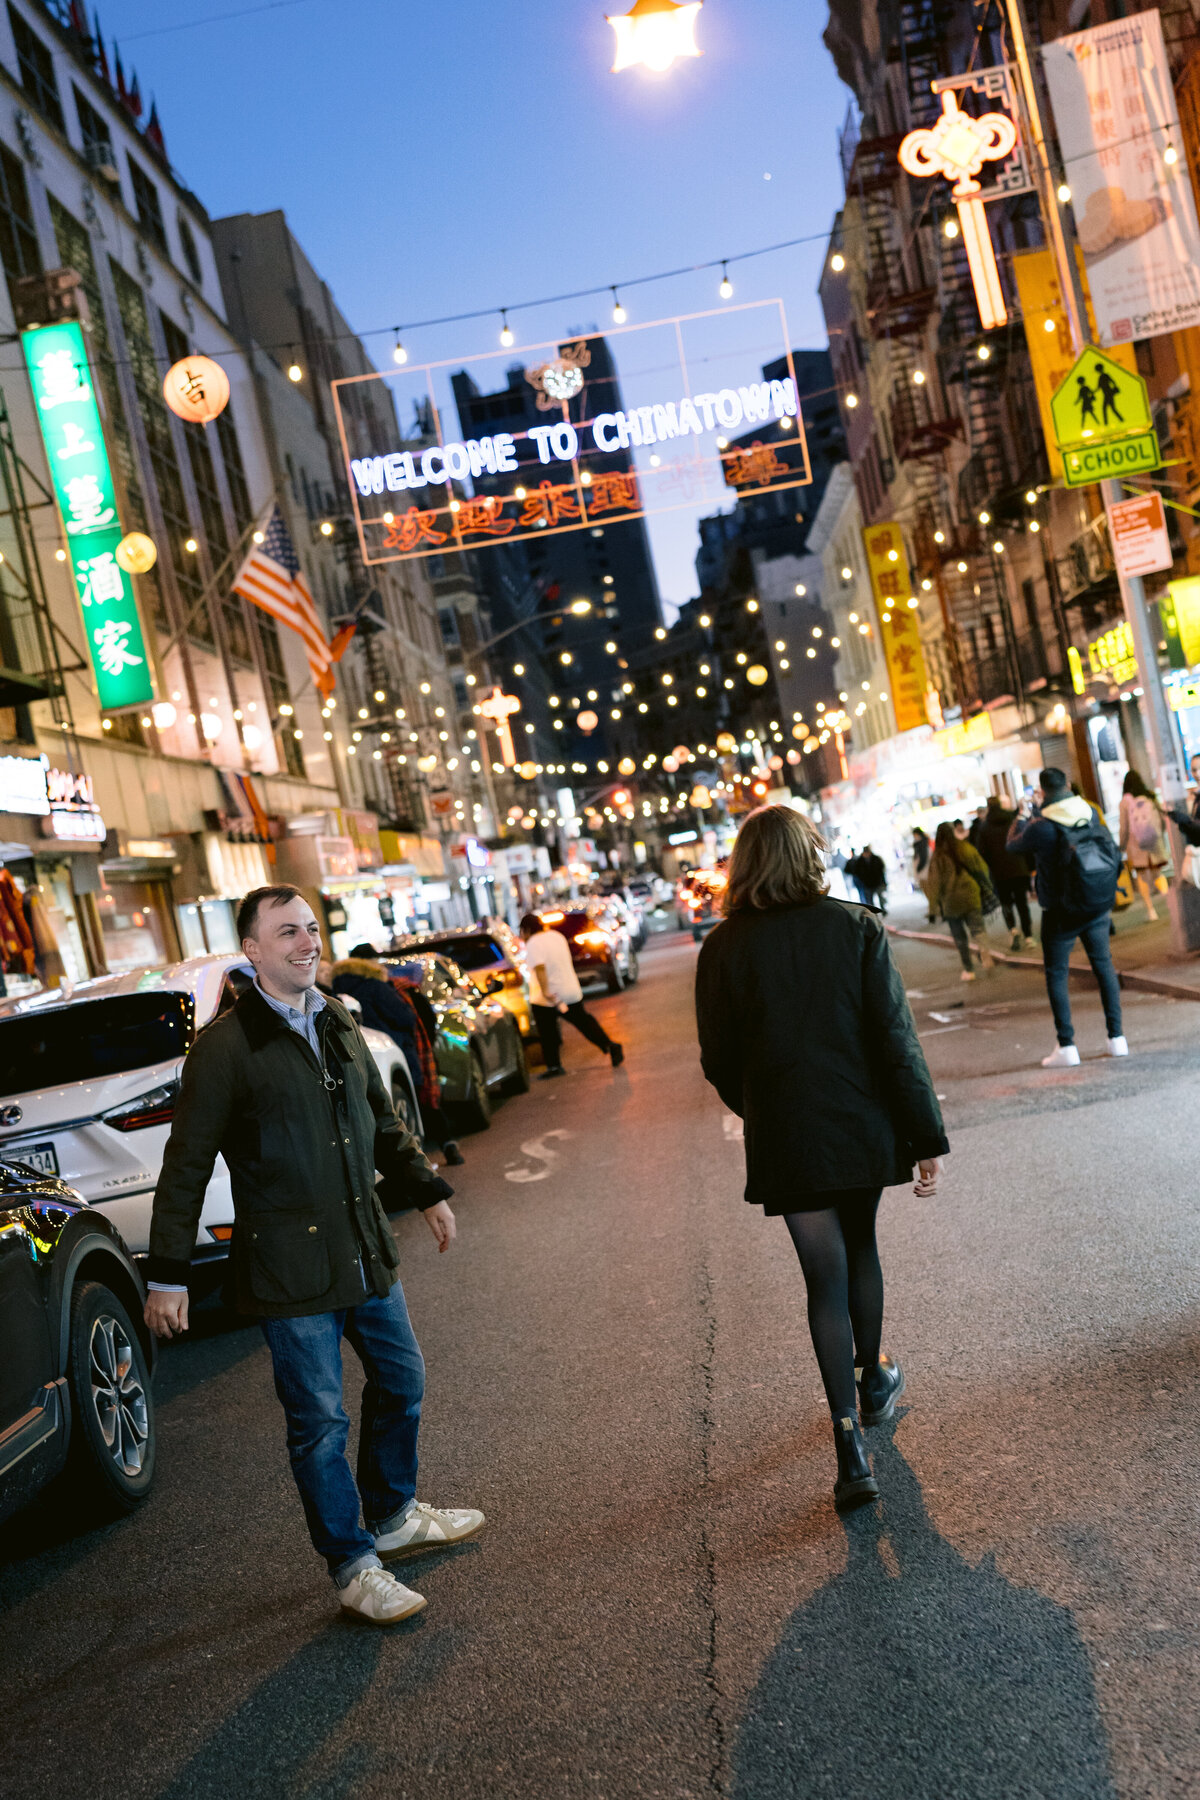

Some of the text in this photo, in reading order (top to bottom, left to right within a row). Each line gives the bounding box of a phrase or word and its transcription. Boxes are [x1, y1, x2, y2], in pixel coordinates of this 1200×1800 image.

[350, 377, 798, 497] WELCOME TO CHINATOWN
